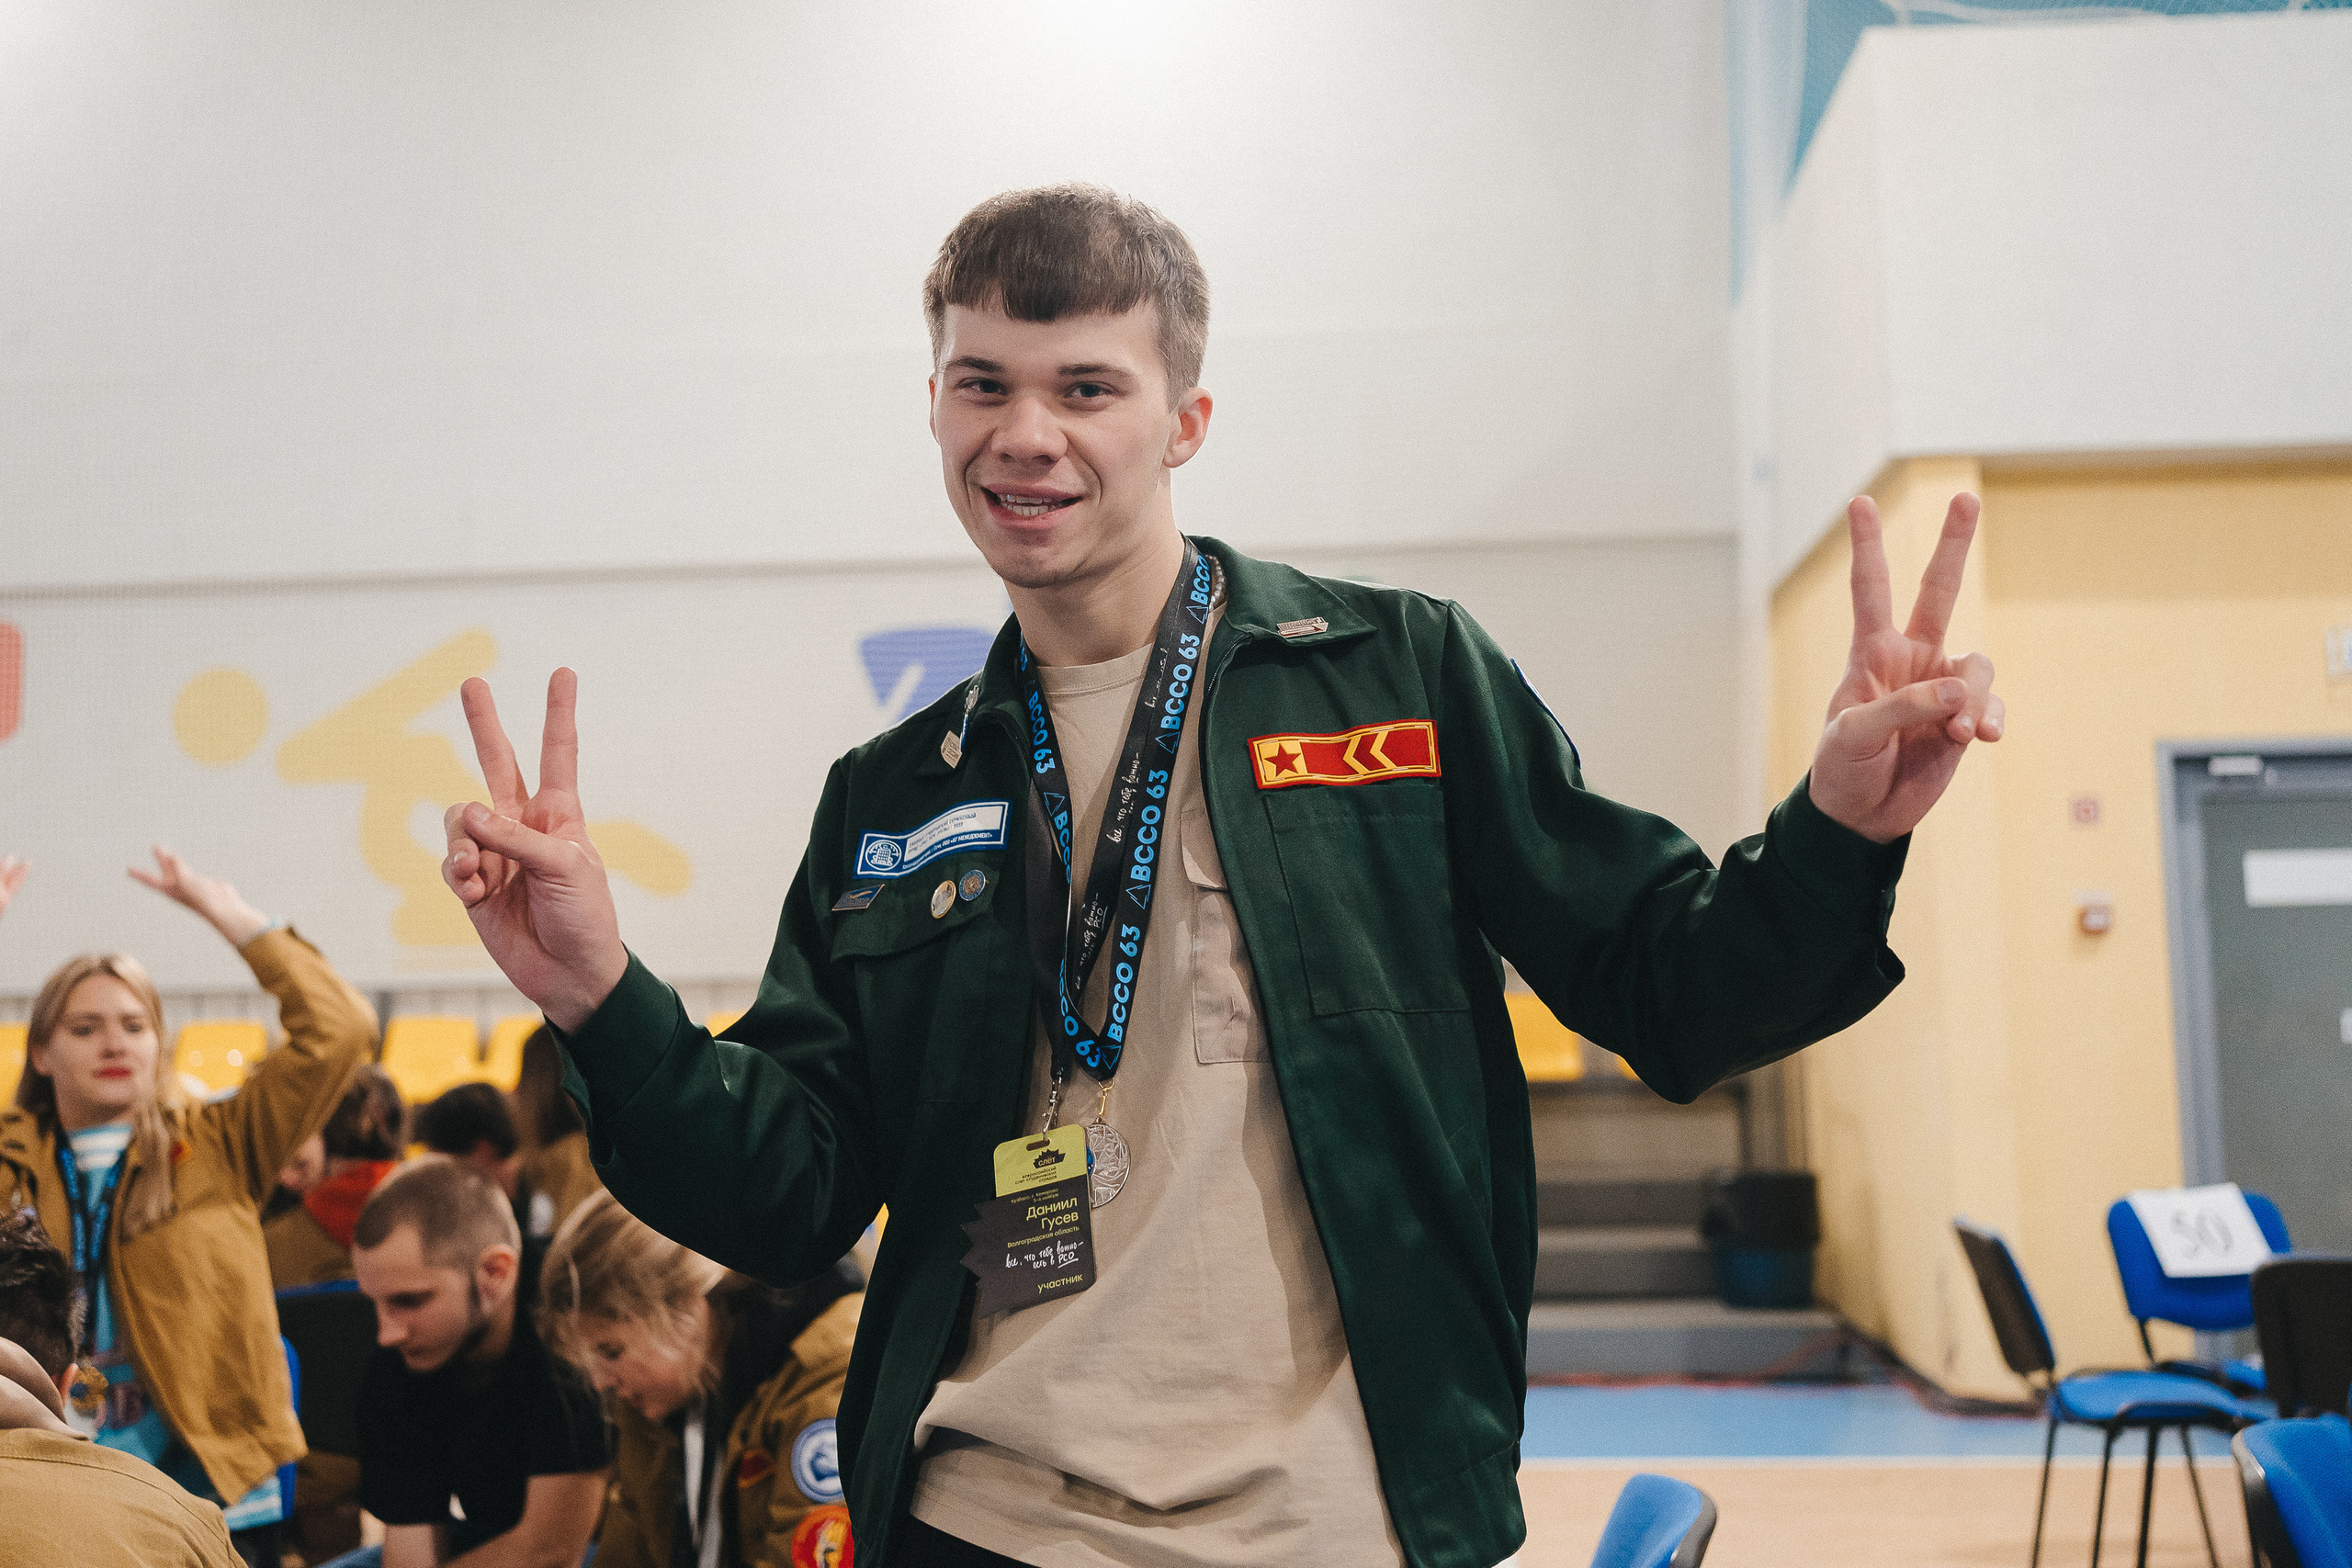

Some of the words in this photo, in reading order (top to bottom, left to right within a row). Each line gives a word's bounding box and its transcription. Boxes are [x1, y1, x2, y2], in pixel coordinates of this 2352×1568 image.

[1191, 555, 1210, 604] ВССО
[1160, 663, 1193, 729] ВССО
[1178, 633, 1200, 660] 63
[1028, 691, 1048, 746] ВССО
[1034, 749, 1056, 774] 63
[1130, 805, 1162, 882] ВССО
[1147, 770, 1168, 799] 63
[1093, 908, 1103, 929] РСО
[1107, 963, 1133, 1043] ВССО
[1120, 924, 1141, 957] 63
[1076, 1040, 1101, 1067] 63
[1026, 1197, 1078, 1221] Даниил
[1041, 1212, 1079, 1232] Гусев
[1007, 1232, 1054, 1248] Волгоградская
[1054, 1225, 1080, 1237] область
[1024, 1253, 1036, 1262] что
[1039, 1246, 1054, 1258] тебе
[1058, 1251, 1075, 1264] РСО
[1037, 1273, 1083, 1293] участник
